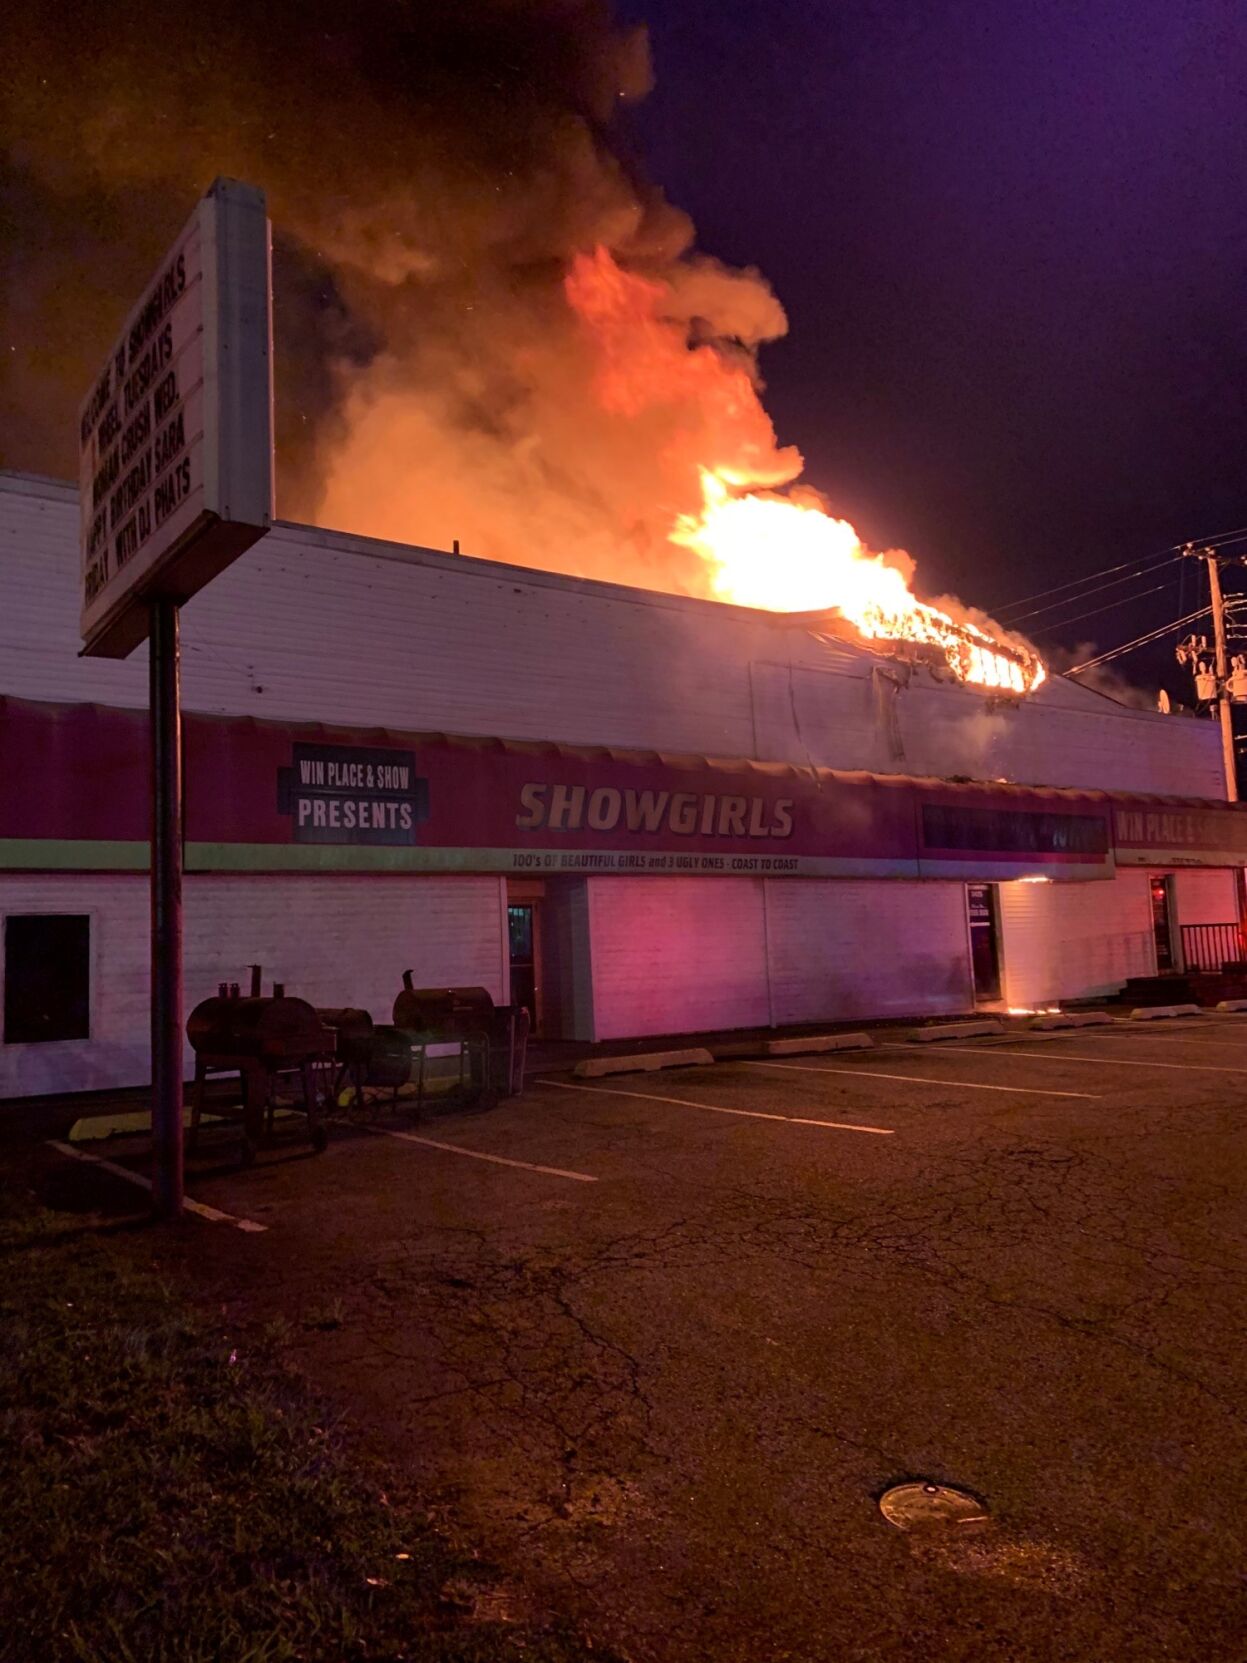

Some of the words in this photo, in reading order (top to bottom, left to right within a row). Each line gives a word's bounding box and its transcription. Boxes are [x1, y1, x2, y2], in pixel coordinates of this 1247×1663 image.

[124, 322, 173, 417] TUESDAYS
[121, 400, 150, 465] CRUSH
[111, 446, 152, 529] BIRTHDAY
[155, 411, 185, 474] SARA
[116, 515, 138, 568] WITH
[138, 500, 151, 542] DJ
[154, 456, 191, 526] PHATS
[300, 760, 324, 785] WIN
[328, 762, 364, 788] PLACE
[366, 764, 374, 788] &
[377, 765, 409, 790] SHOW
[298, 798, 413, 830] PRESENTS
[515, 782, 794, 839] SHOWGIRLS
[513, 854, 541, 868] 100's
[560, 855, 616, 868] BEAUTIFUL
[618, 855, 646, 868] GIRLS
[648, 856, 667, 868] and
[676, 856, 699, 869] UGLY
[701, 857, 724, 870] ONES
[732, 858, 759, 871] COAST
[760, 858, 771, 871] TO
[773, 858, 799, 871] COAST
